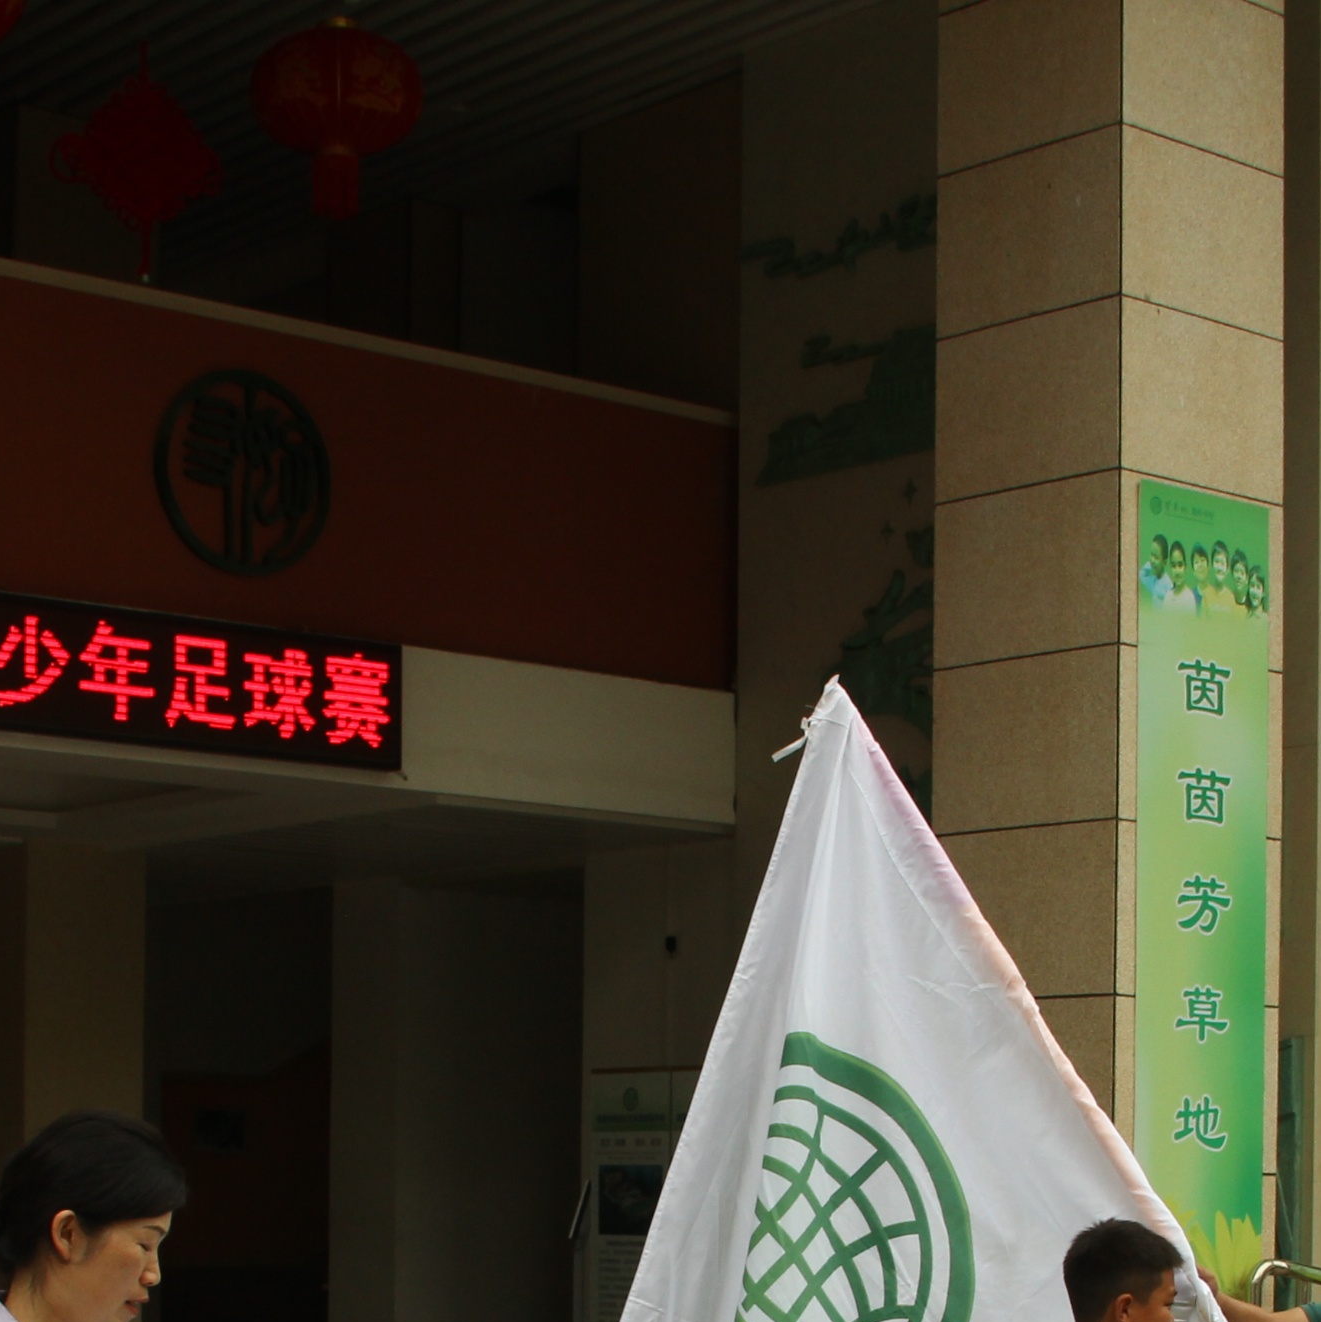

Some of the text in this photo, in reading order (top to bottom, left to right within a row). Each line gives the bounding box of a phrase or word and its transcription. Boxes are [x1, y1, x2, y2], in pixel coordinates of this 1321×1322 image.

[1174, 659, 1232, 1153] 茵茵芳草地
